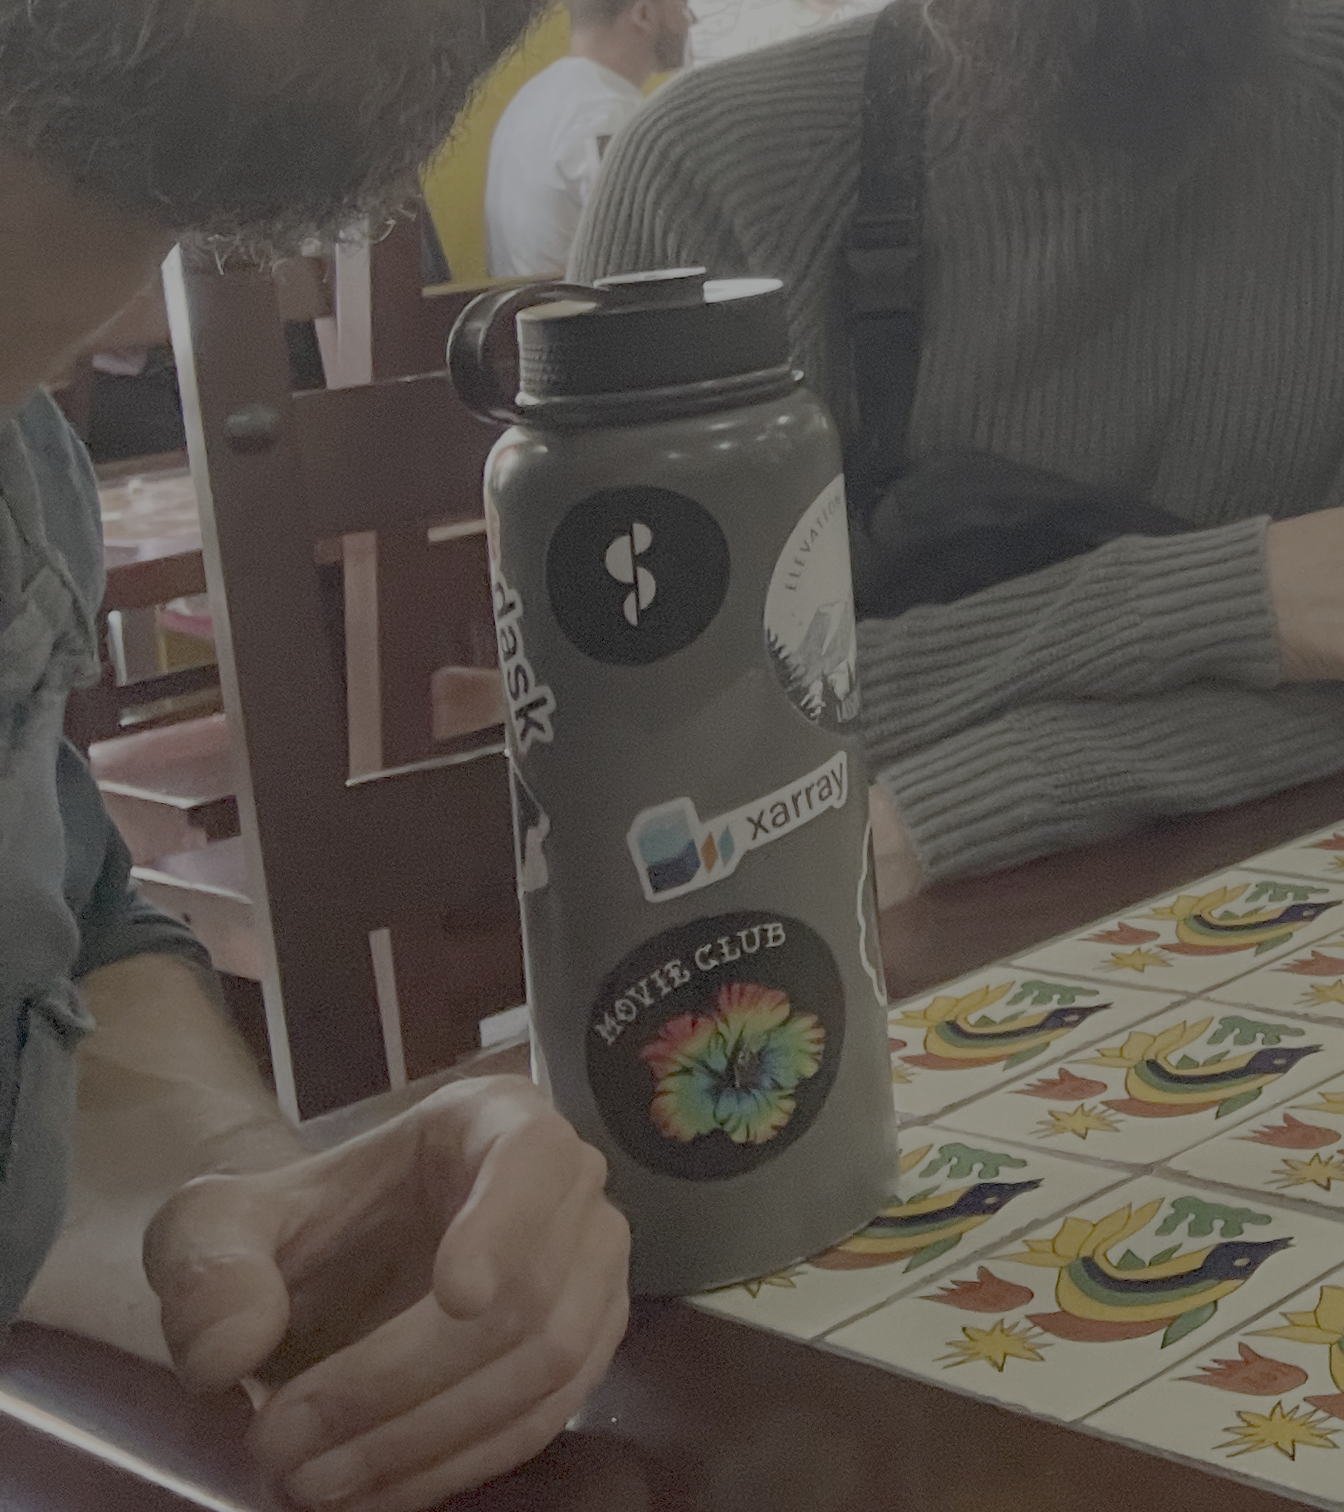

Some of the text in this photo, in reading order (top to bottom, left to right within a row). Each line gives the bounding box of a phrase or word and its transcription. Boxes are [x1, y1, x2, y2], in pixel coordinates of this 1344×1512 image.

[493, 579, 549, 743] dask
[745, 761, 845, 842] xarray
[593, 921, 787, 1047] MOVIE CLUB
